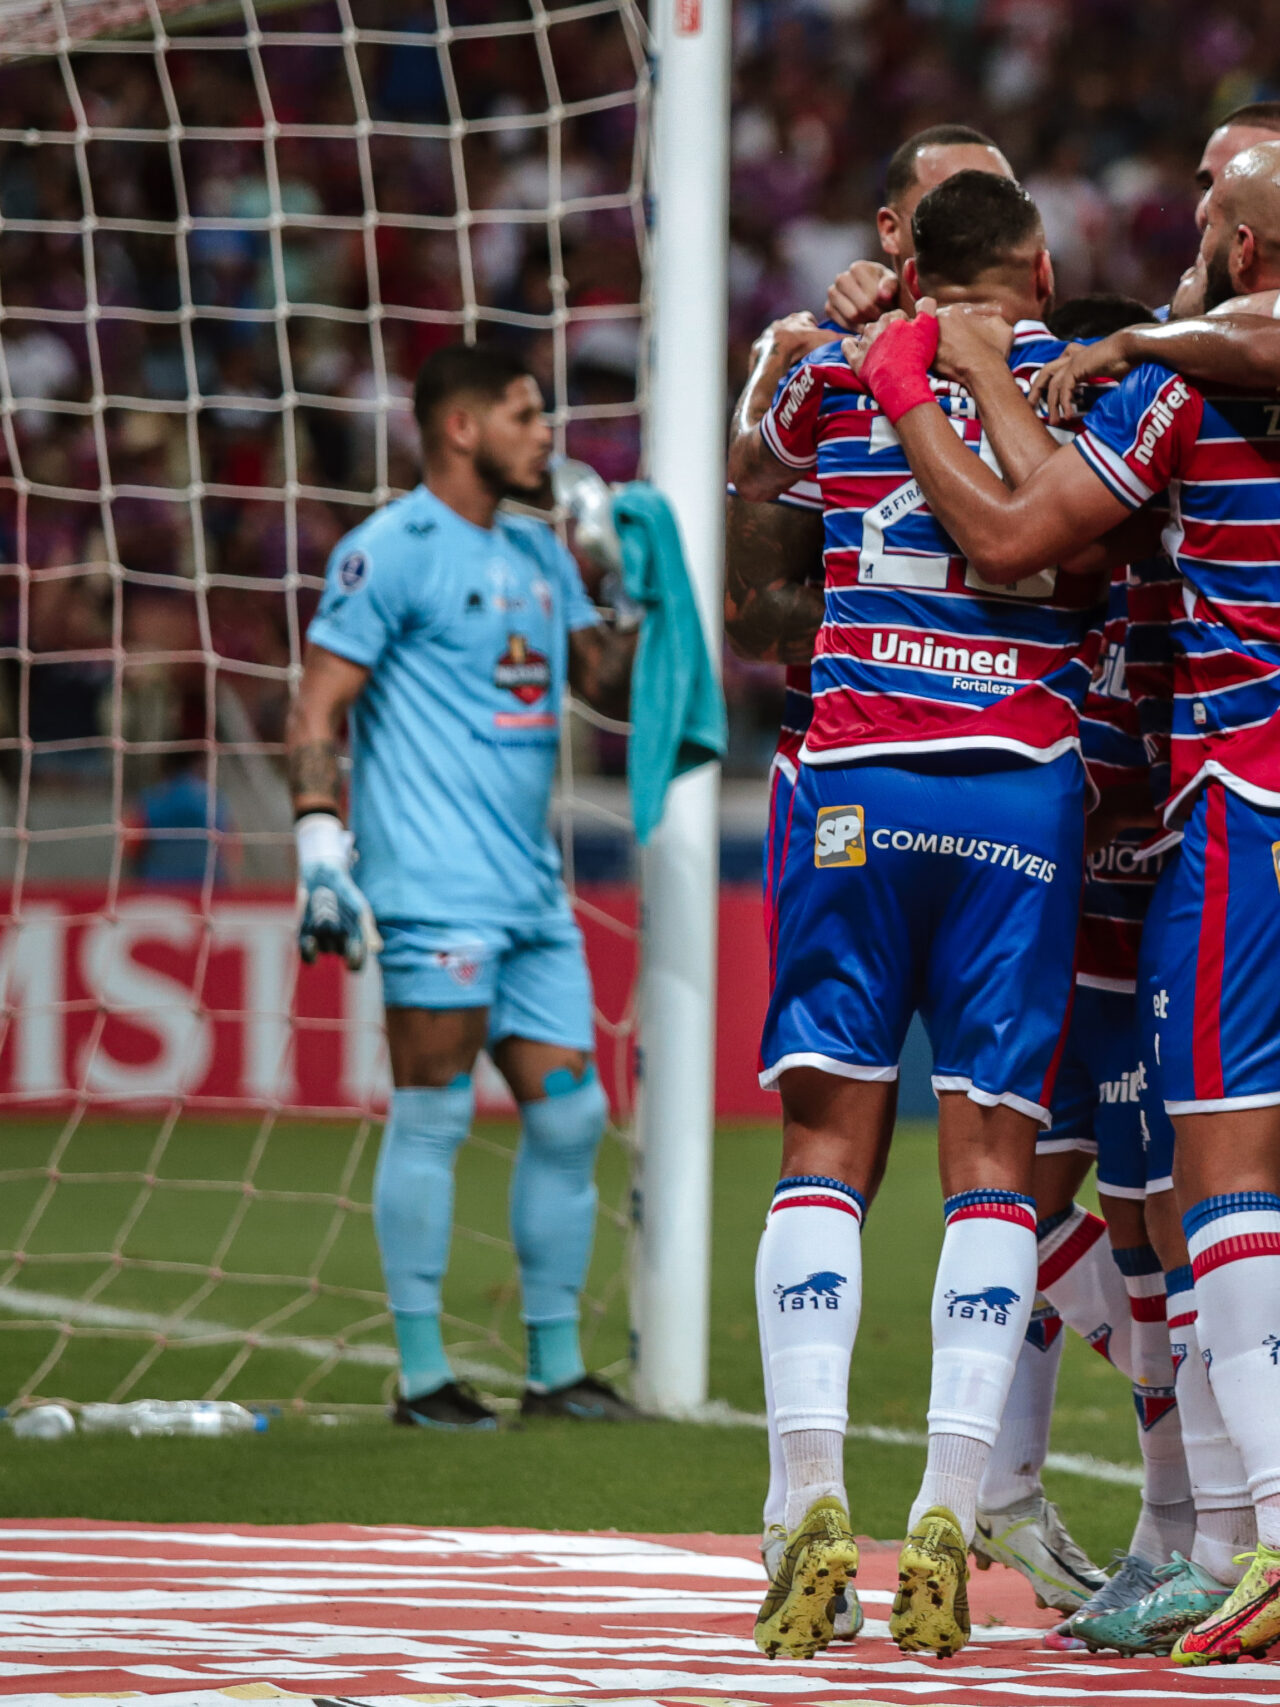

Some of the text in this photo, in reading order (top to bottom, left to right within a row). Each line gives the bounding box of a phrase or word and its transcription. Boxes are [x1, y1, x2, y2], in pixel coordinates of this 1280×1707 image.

[871, 632, 1020, 678] Unimed
[952, 677, 1016, 697] Fortaleza
[815, 815, 1058, 884] SP COMBUSTÍVEIS
[778, 1296, 840, 1313] 1918
[947, 1305, 1007, 1326] 1918
